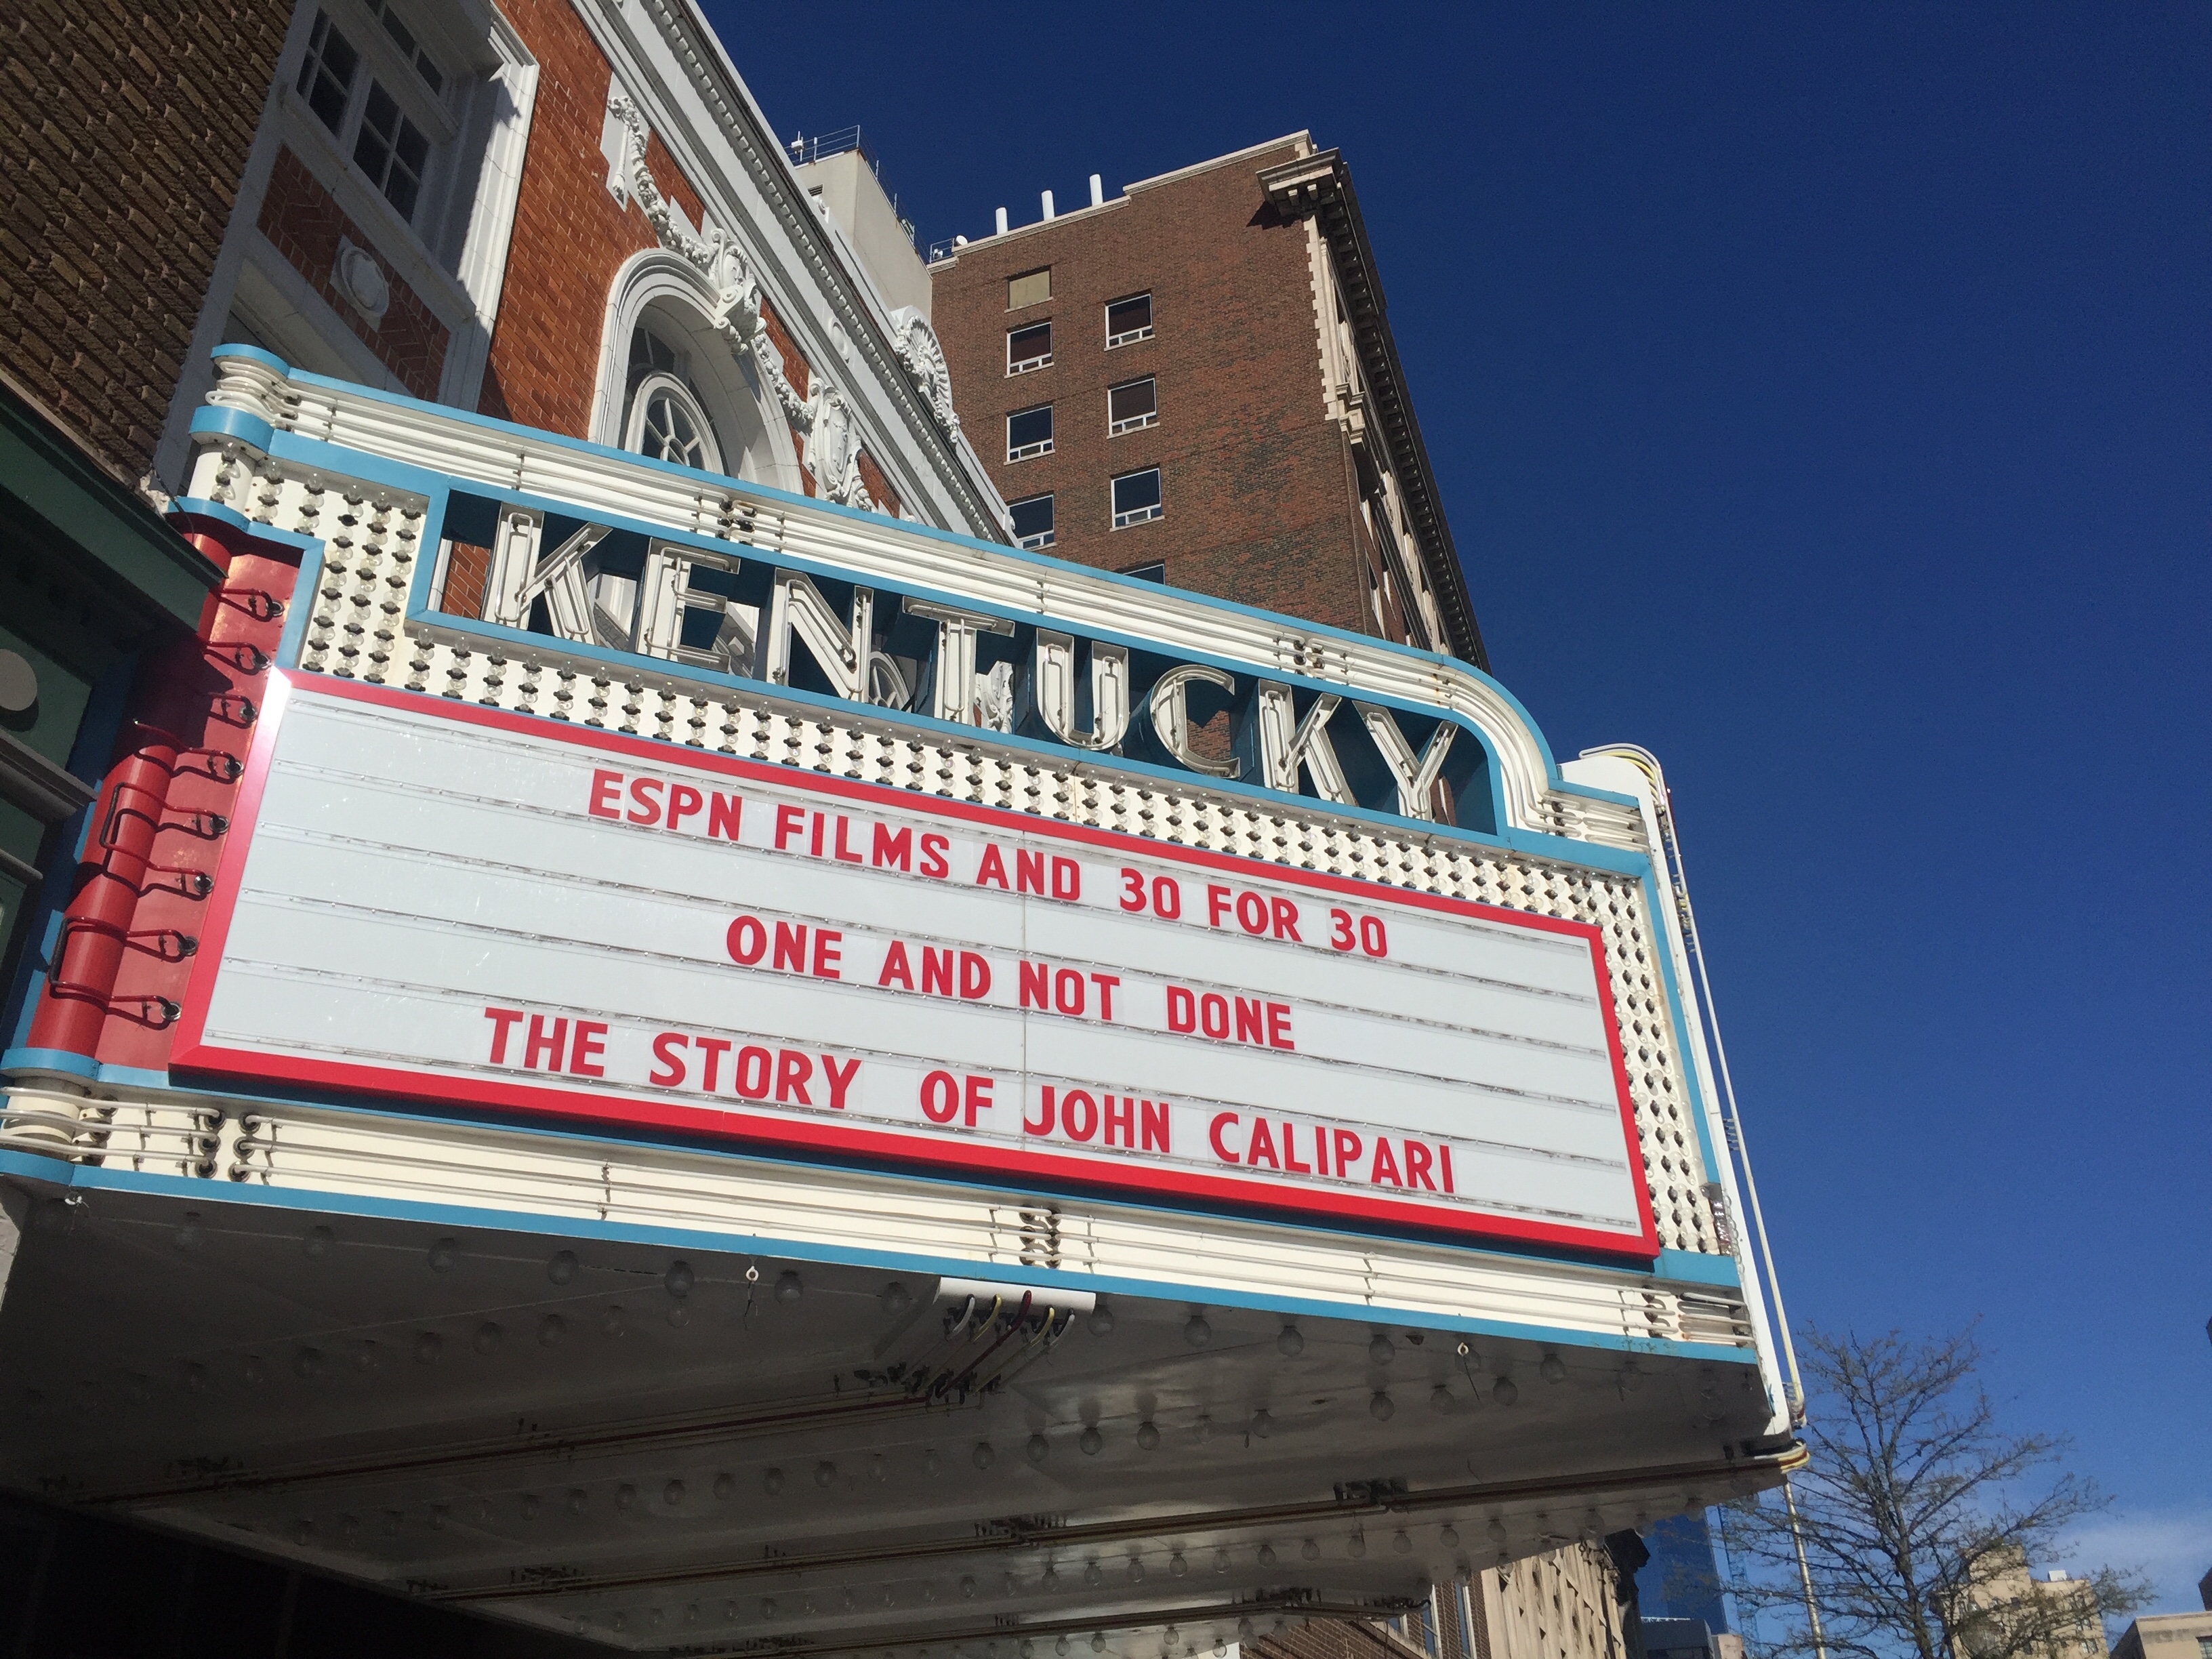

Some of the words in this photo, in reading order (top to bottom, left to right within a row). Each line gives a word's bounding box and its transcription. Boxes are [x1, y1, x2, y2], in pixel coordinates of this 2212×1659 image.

[480, 501, 1458, 821] KENTUCKY
[589, 769, 742, 841] ESPN
[775, 804, 949, 879] FILMS
[976, 843, 1080, 901] AND
[1120, 867, 1181, 920] 30
[1208, 884, 1302, 942] FOR
[1330, 908, 1388, 958] 30
[726, 915, 842, 980] ONE
[878, 940, 991, 1000] AND
[1019, 960, 1120, 1021] NOT
[1166, 985, 1295, 1050] DONE
[485, 1007, 609, 1078] THE
[649, 1031, 861, 1109] STORY
[920, 1069, 994, 1128] OF
[1023, 1085, 1170, 1153] JOHN
[1208, 1111, 1454, 1193] CALIPARI
